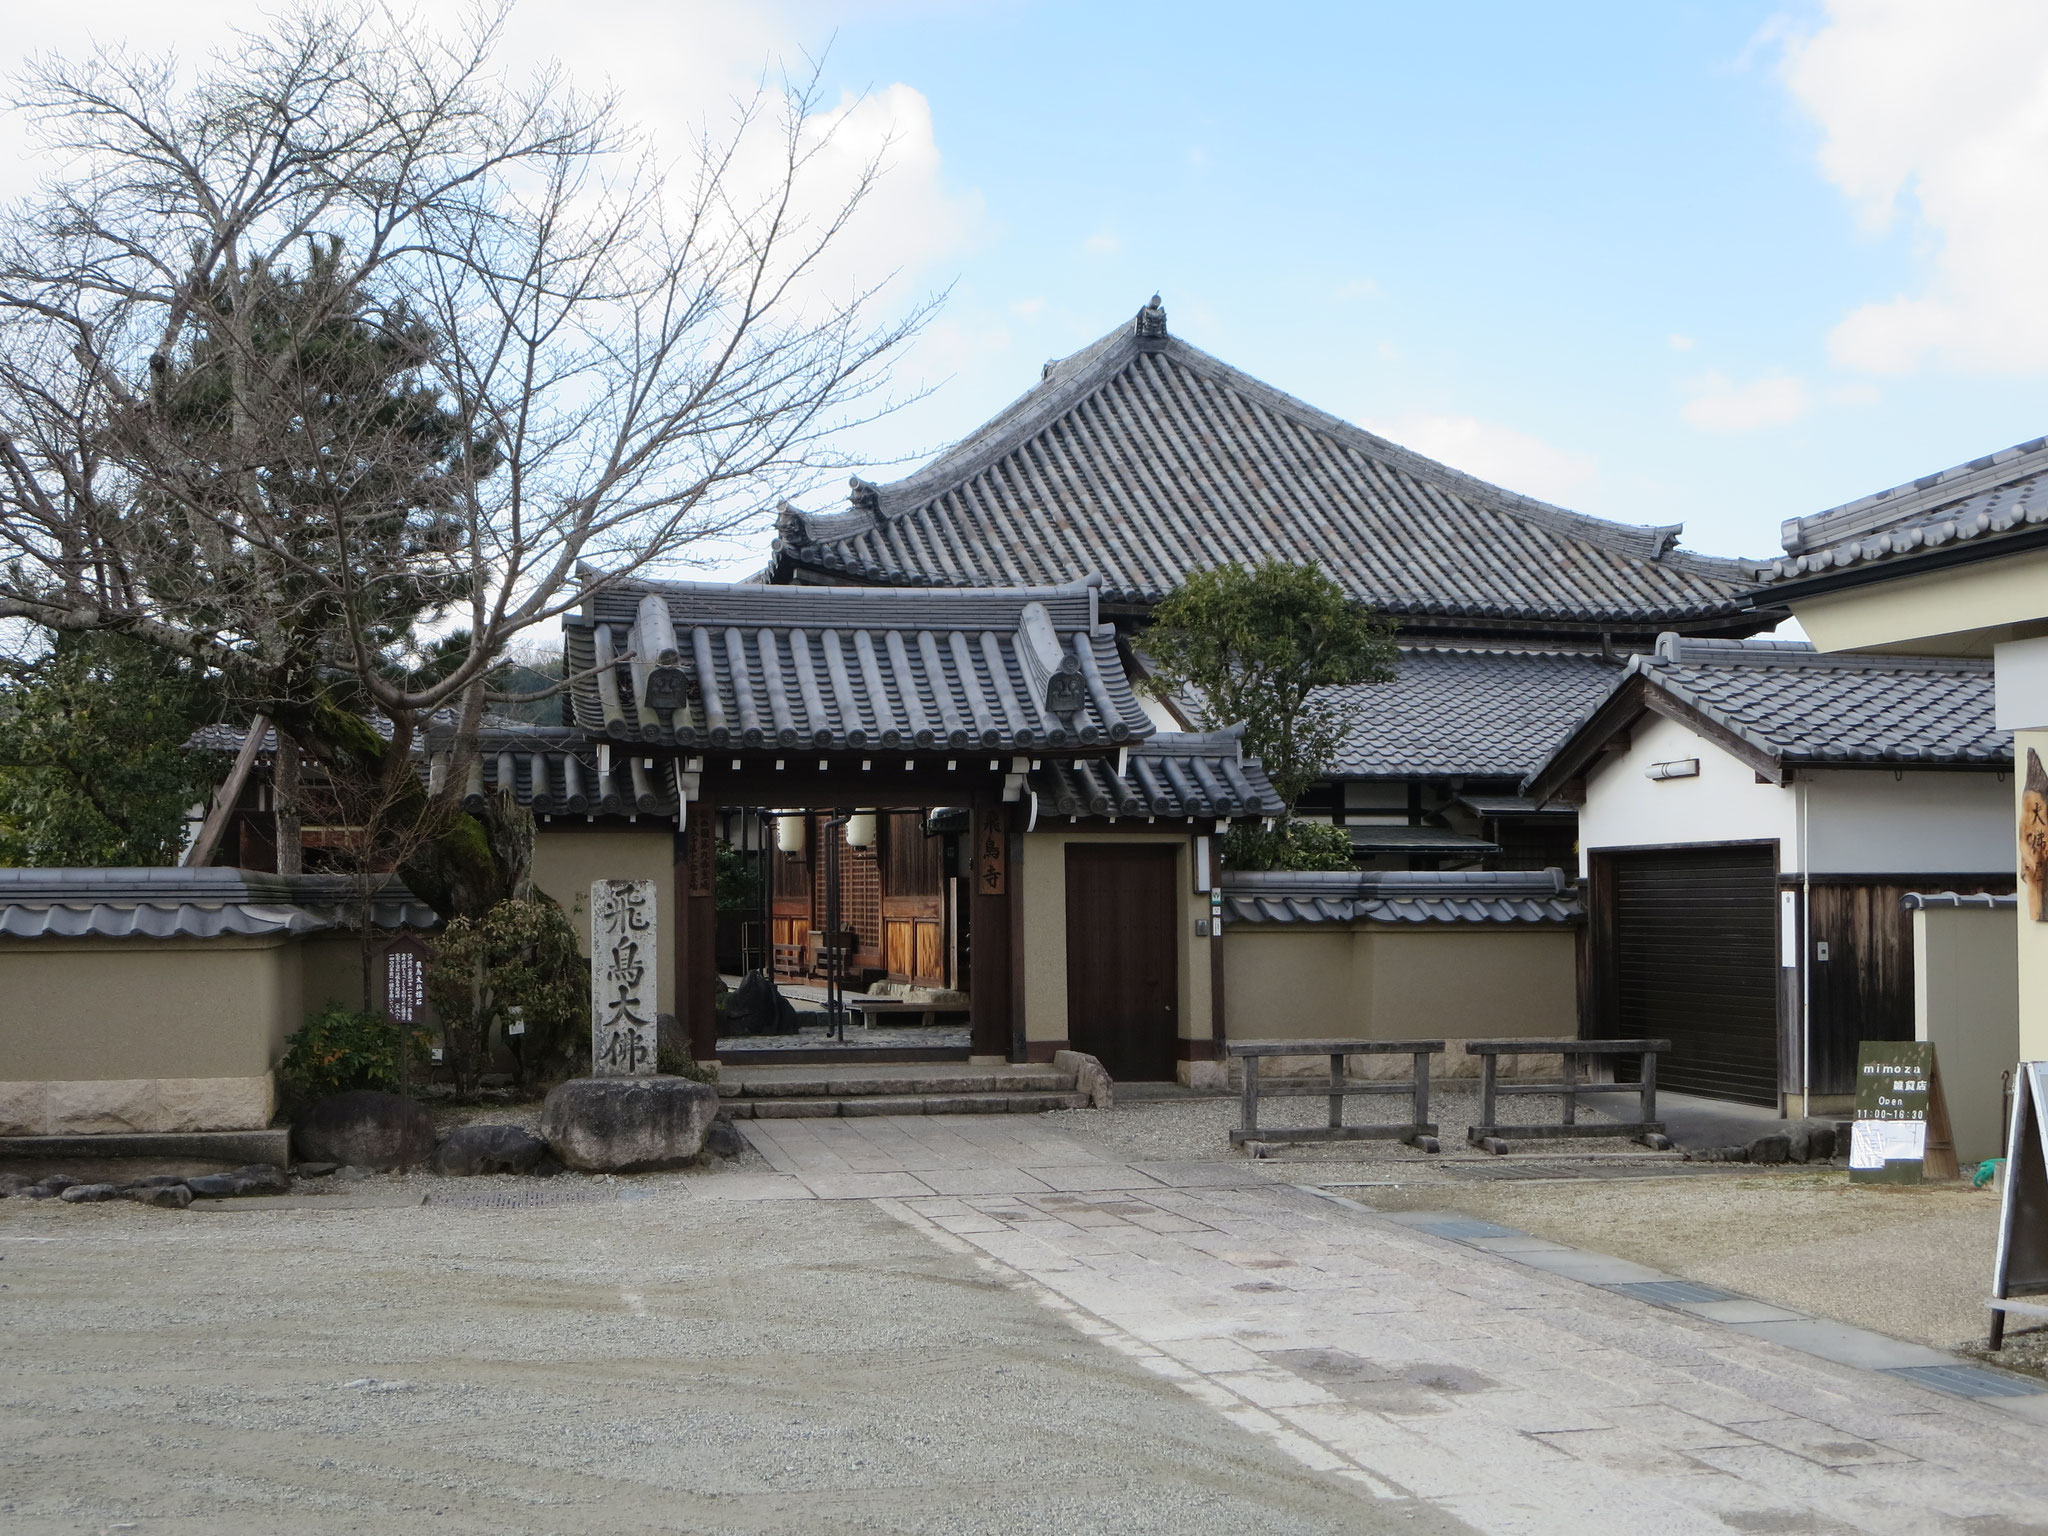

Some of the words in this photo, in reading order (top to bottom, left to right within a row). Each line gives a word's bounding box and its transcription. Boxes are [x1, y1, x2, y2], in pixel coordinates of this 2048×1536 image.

[983, 810, 1002, 888] 飛鳥寺
[600, 884, 650, 1073] 飛鳥大佛
[1863, 1064, 1921, 1074] mimoza
[1893, 1080, 1928, 1091] 雑貨店
[1878, 1096, 1903, 1106] Open
